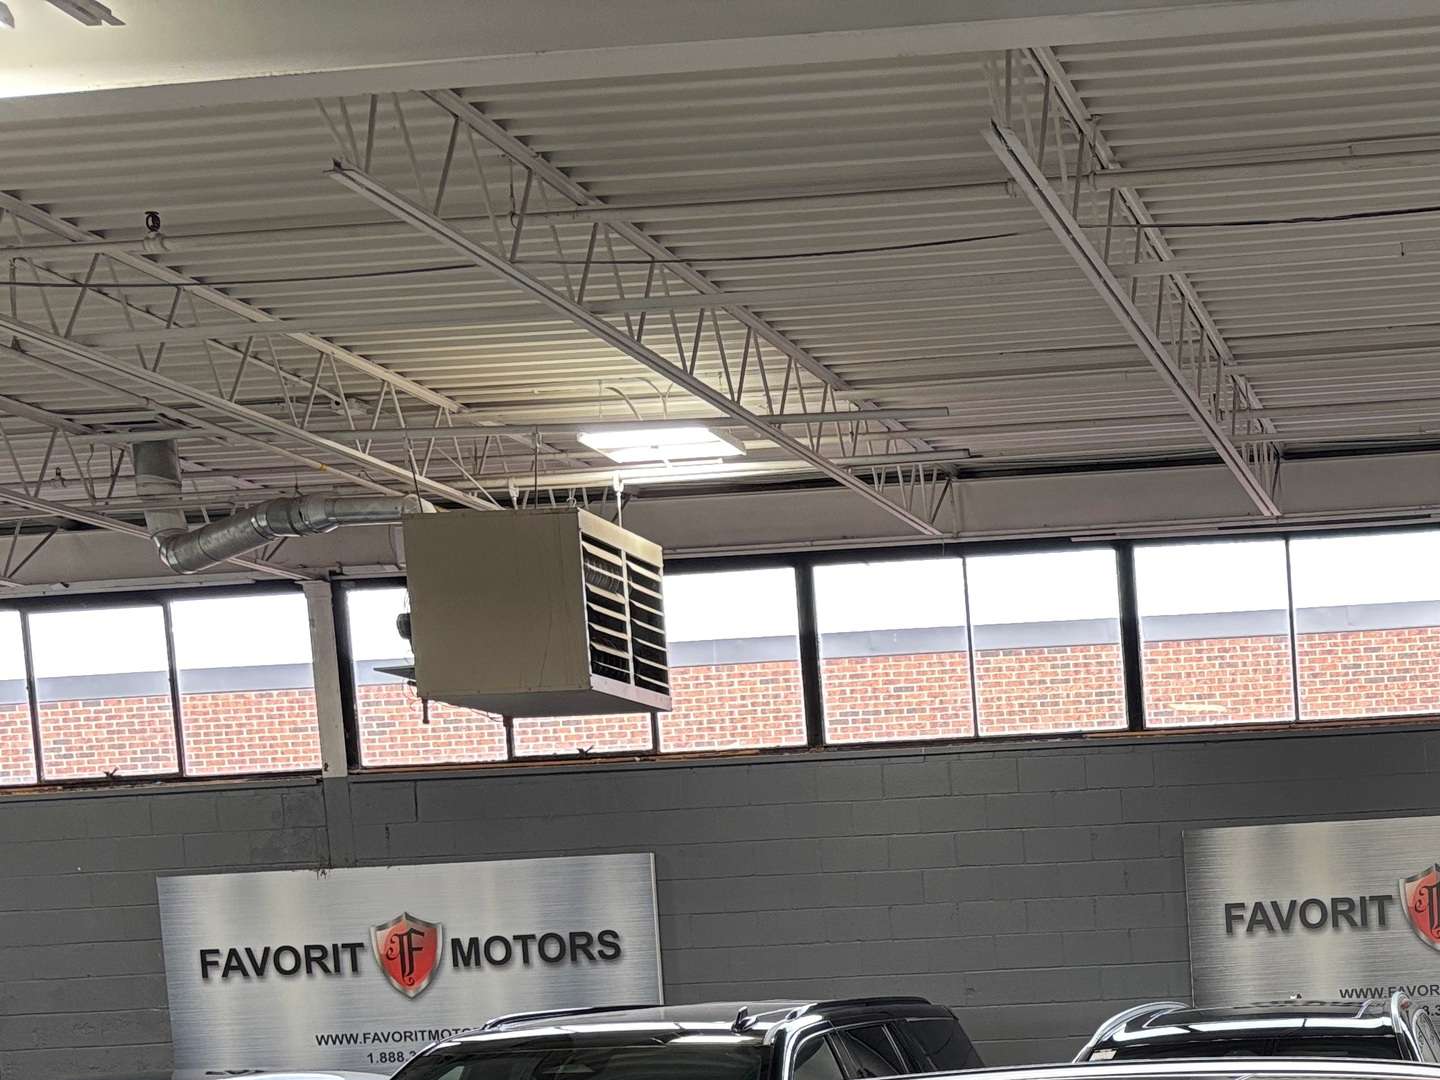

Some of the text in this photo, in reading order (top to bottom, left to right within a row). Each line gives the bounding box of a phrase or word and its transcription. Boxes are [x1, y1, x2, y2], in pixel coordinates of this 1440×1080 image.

[1224, 895, 1392, 933] FAVORIT
[201, 942, 364, 979] FAVORIT
[451, 929, 622, 968] MOTORS
